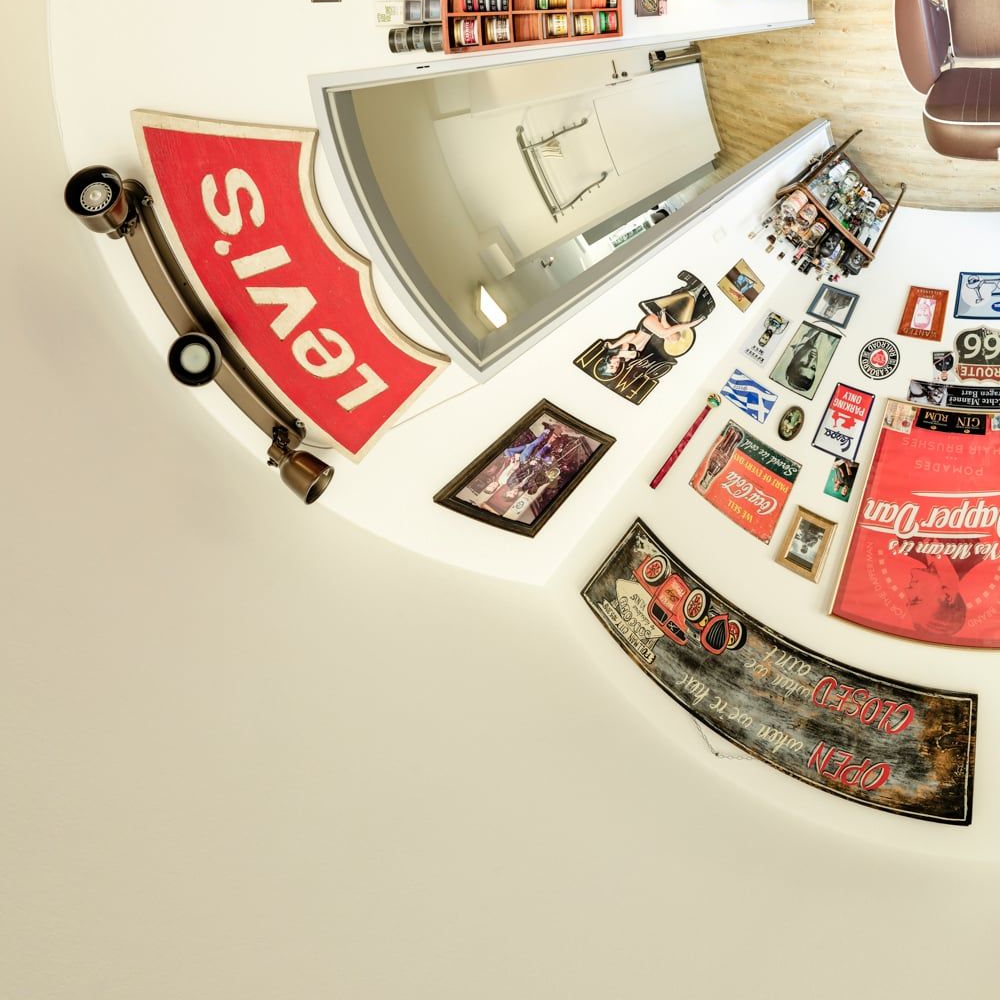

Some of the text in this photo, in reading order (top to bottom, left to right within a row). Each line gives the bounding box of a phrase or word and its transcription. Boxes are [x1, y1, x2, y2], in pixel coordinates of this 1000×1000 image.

[867, 340, 896, 356] RAILROAD
[962, 333, 1000, 360] 66
[573, 339, 656, 404] LEMON
[862, 359, 892, 376] SEABOARD
[959, 365, 1000, 376] ROUTE
[842, 390, 862, 404] ONLY
[948, 395, 979, 406] Männer
[960, 388, 978, 397] Bart
[832, 398, 865, 416] PARKING
[924, 410, 948, 422] RUM
[956, 415, 980, 428] GIN
[823, 427, 853, 451] Vespa
[901, 436, 1000, 455] HAIR BRUSHES
[739, 437, 797, 476] Served ice cold
[914, 458, 983, 475] POMADES
[719, 469, 778, 516] Coca-Cola
[726, 499, 753, 522] WE SELL
[862, 497, 919, 537] Dan
[887, 539, 914, 556] it's
[916, 541, 970, 560] Ma'am
[742, 656, 915, 735] CLOSED when we
[707, 692, 753, 731] we're
[756, 722, 802, 756] when
[805, 737, 892, 791] OPEN
